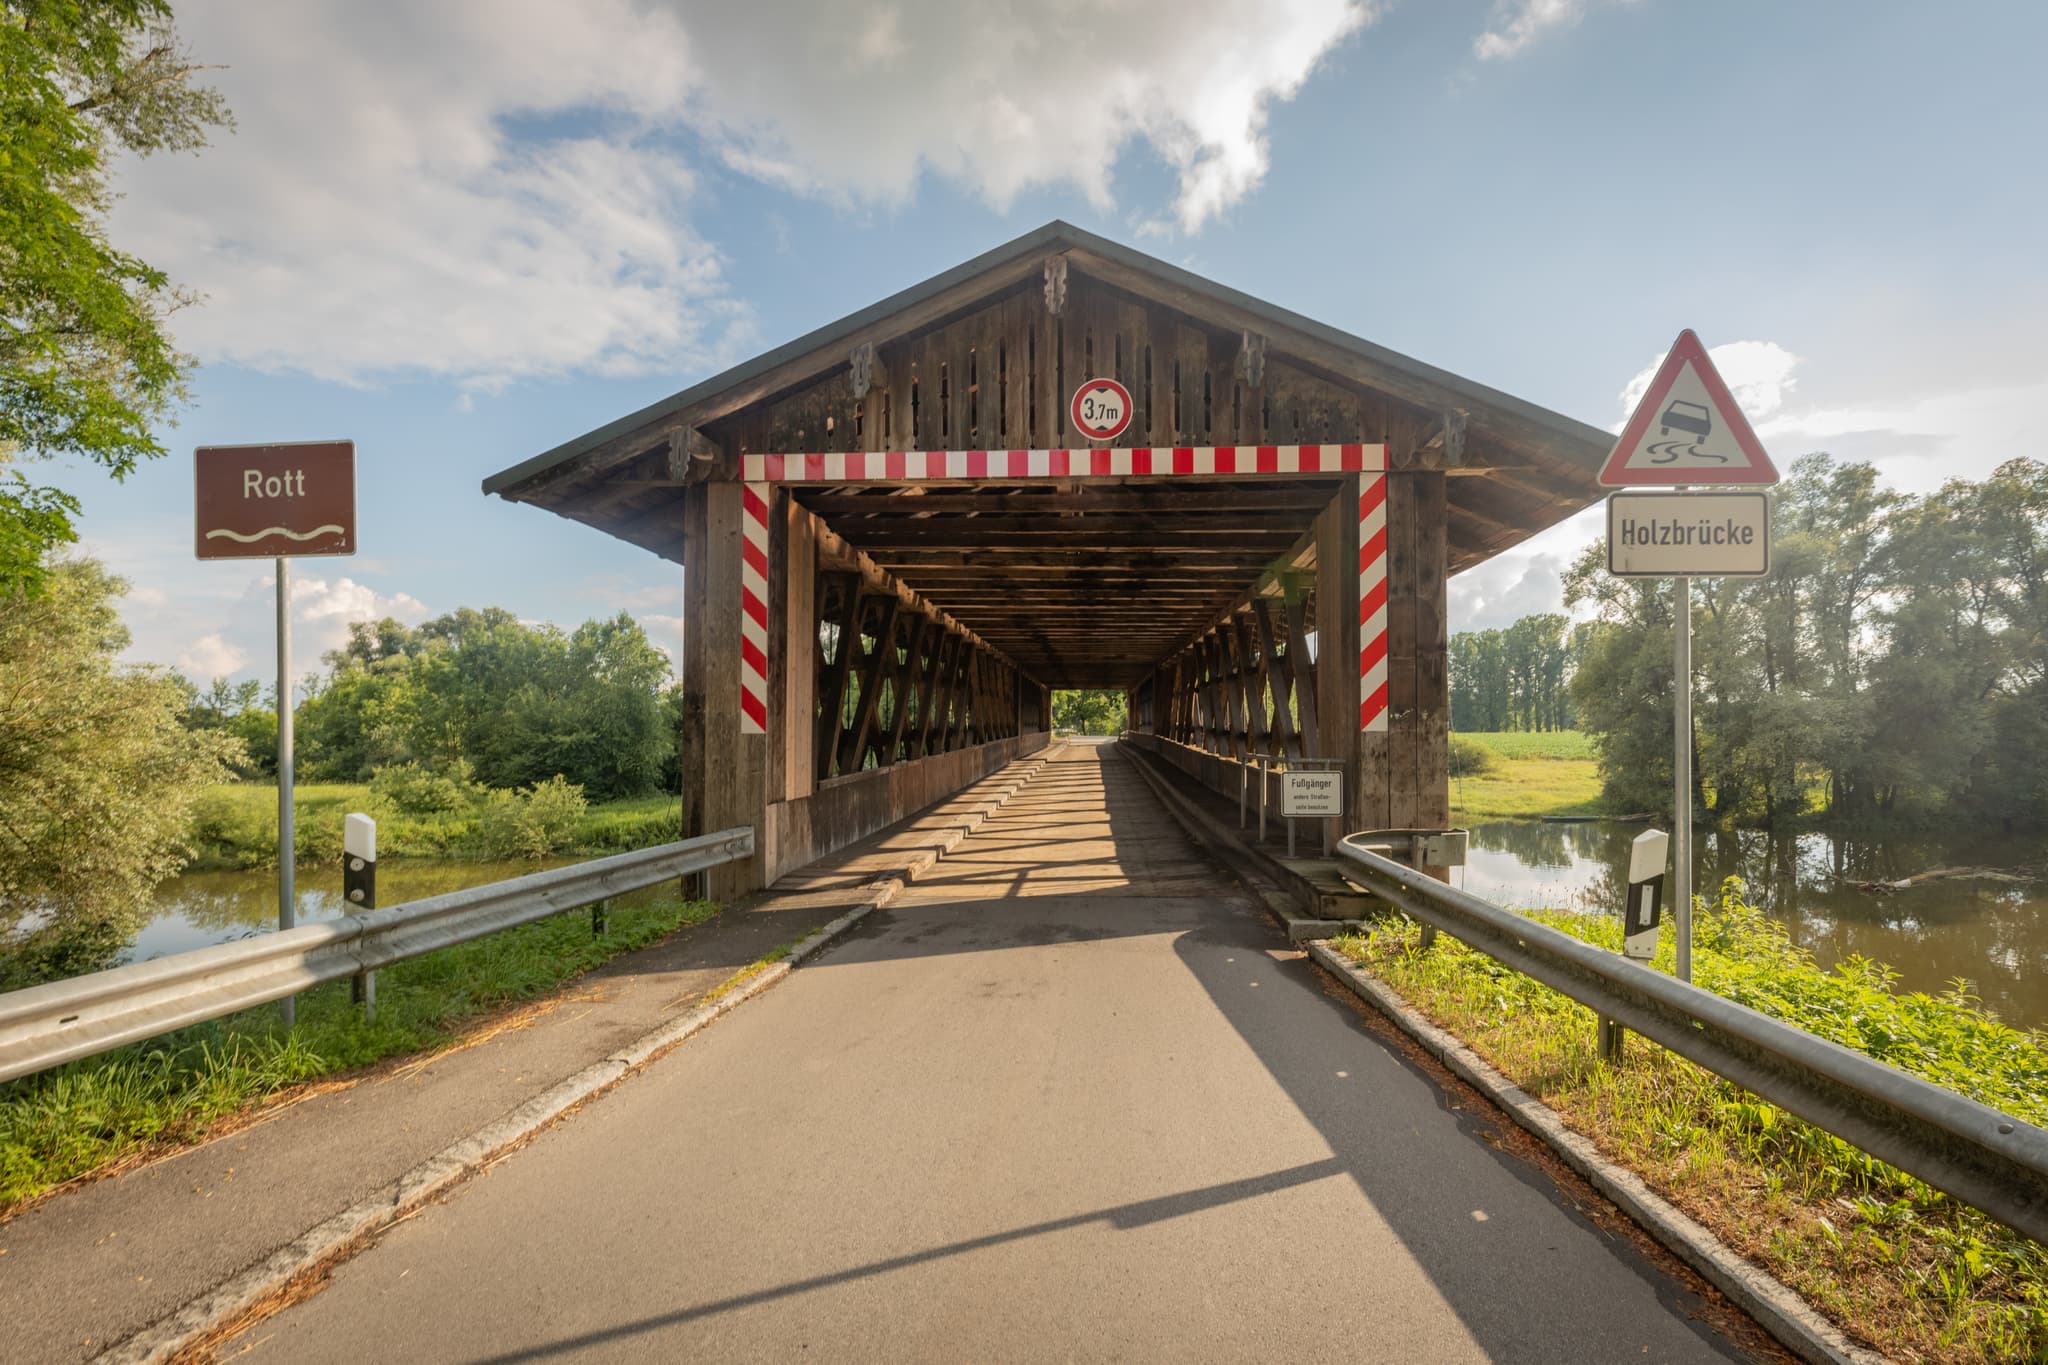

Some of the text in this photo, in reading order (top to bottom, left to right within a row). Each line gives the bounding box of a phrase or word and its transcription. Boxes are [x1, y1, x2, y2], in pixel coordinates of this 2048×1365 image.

[243, 469, 306, 499] Rott
[1621, 518, 1754, 545] Holzbrücke
[1291, 778, 1332, 790] Fußgänger
